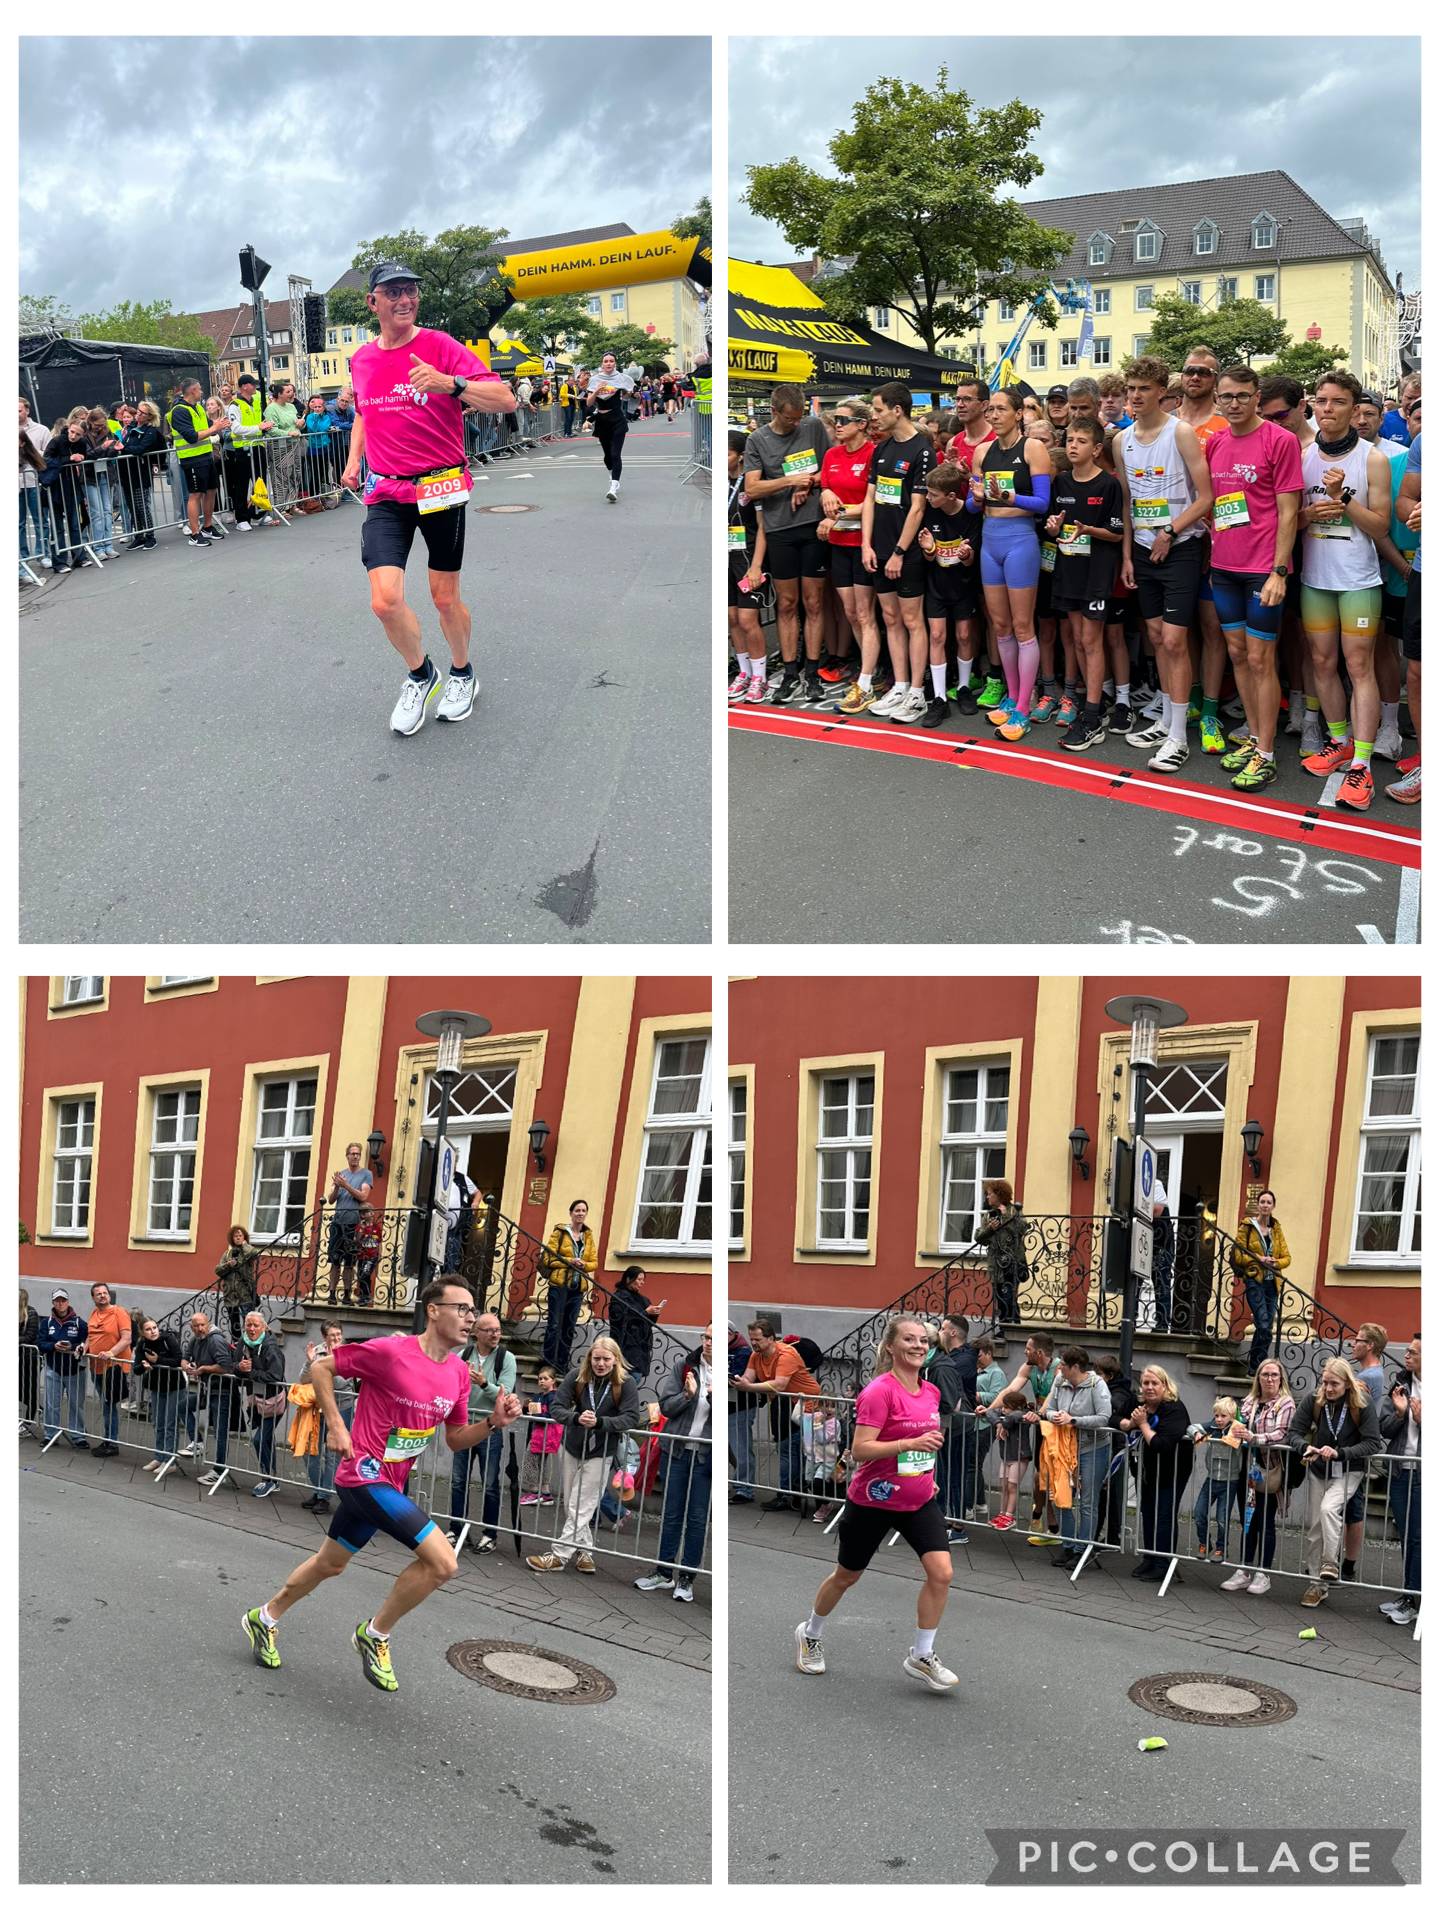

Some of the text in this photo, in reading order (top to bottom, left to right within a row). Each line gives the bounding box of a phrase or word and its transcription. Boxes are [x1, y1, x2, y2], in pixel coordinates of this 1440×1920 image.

[518, 245, 677, 277] DEIN HAMM. DEIN LAUF.
[734, 308, 861, 344] MAXi LAUF
[545, 360, 554, 370] A
[747, 352, 776, 371] LAUF
[823, 361, 913, 379] DEIN HAMM. DEIN LAUF.
[370, 396, 383, 405] bad
[385, 395, 409, 403] hamm
[790, 457, 812, 470] 3532
[423, 478, 461, 497] 2009
[877, 482, 894, 494] 3049
[1137, 507, 1160, 517] 3227
[1215, 502, 1240, 518] 3003
[937, 546, 957, 557] 2215
[1173, 825, 1382, 893] Start
[396, 1396, 412, 1407] reha
[414, 1400, 426, 1410] bad
[395, 1436, 428, 1449] 3003
